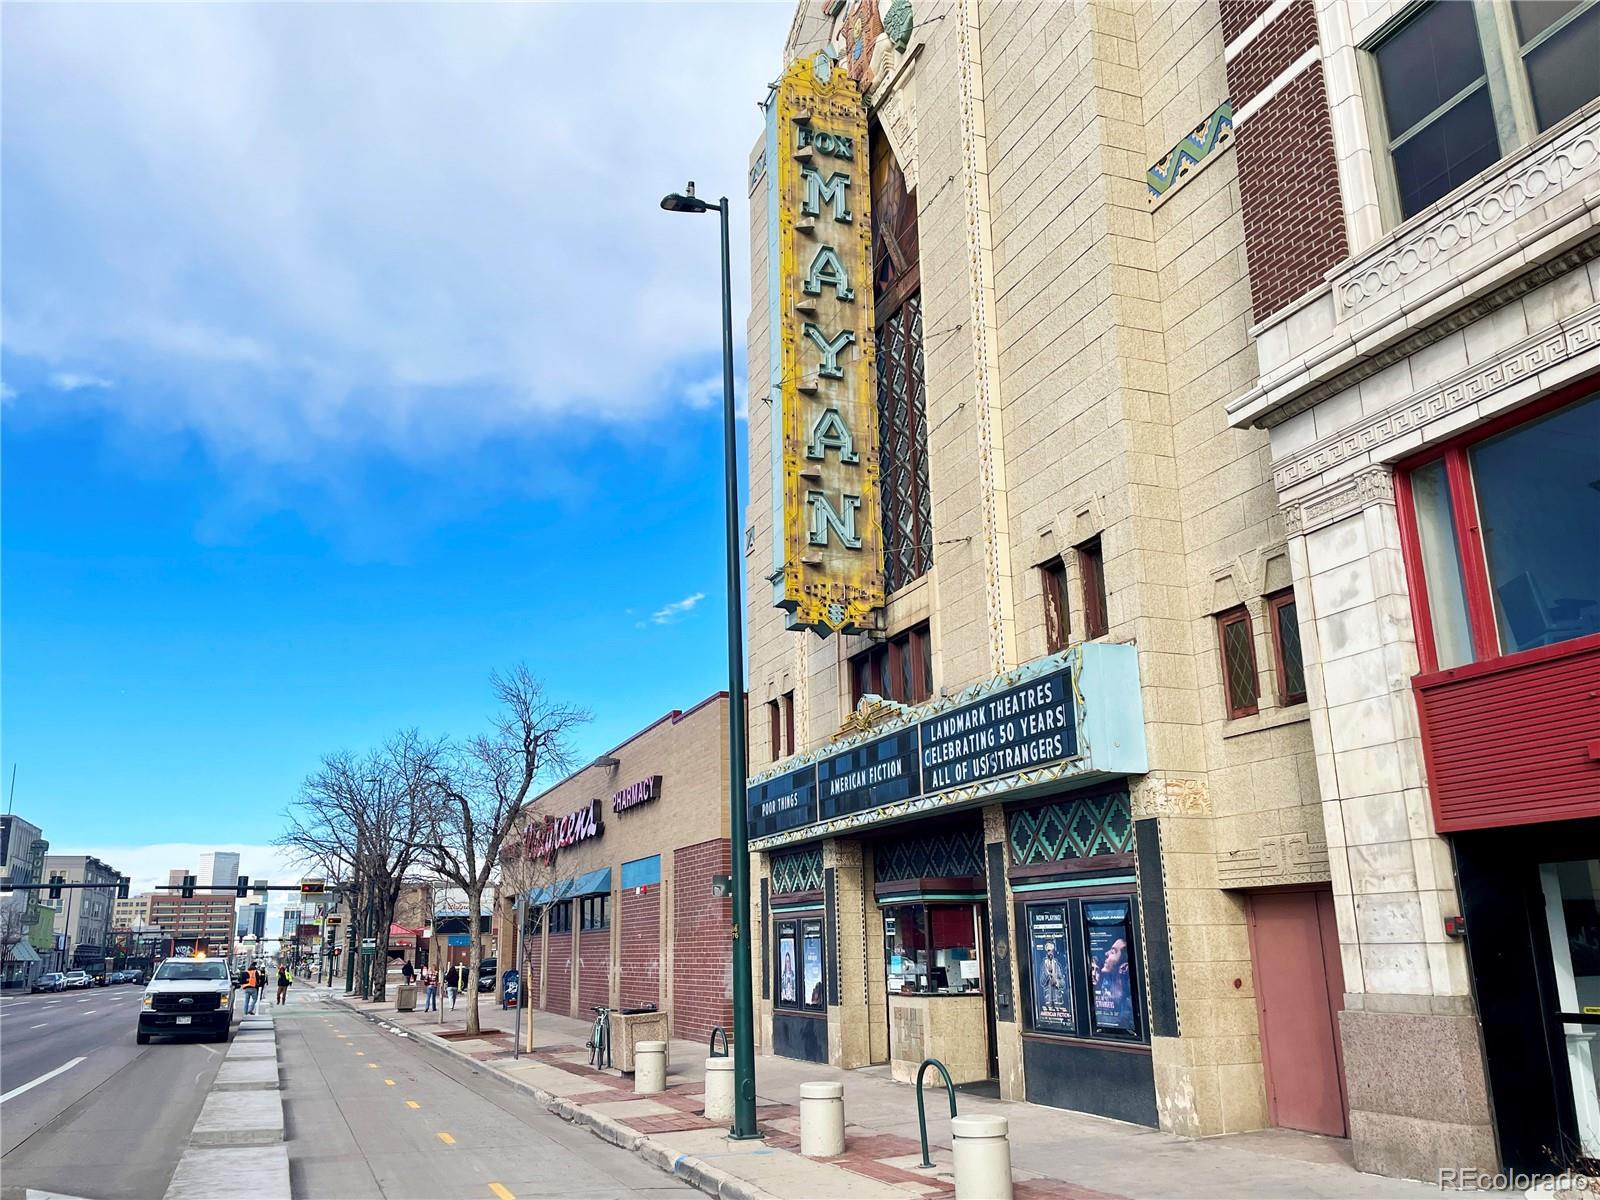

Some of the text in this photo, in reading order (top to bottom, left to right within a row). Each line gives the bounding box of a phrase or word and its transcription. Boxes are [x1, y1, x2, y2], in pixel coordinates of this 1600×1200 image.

[797, 126, 853, 160] FOX
[801, 164, 862, 549] MAYAN
[931, 682, 1052, 742] LANDMARK THEATRES
[925, 706, 1064, 767] CELEBRATING 50 YEARS
[830, 758, 902, 795] AMERICAN FICTION
[932, 768, 950, 788] ALL
[955, 762, 968, 781] OF
[613, 776, 655, 812] PHARMACY
[762, 792, 798, 817] POOR THINGS
